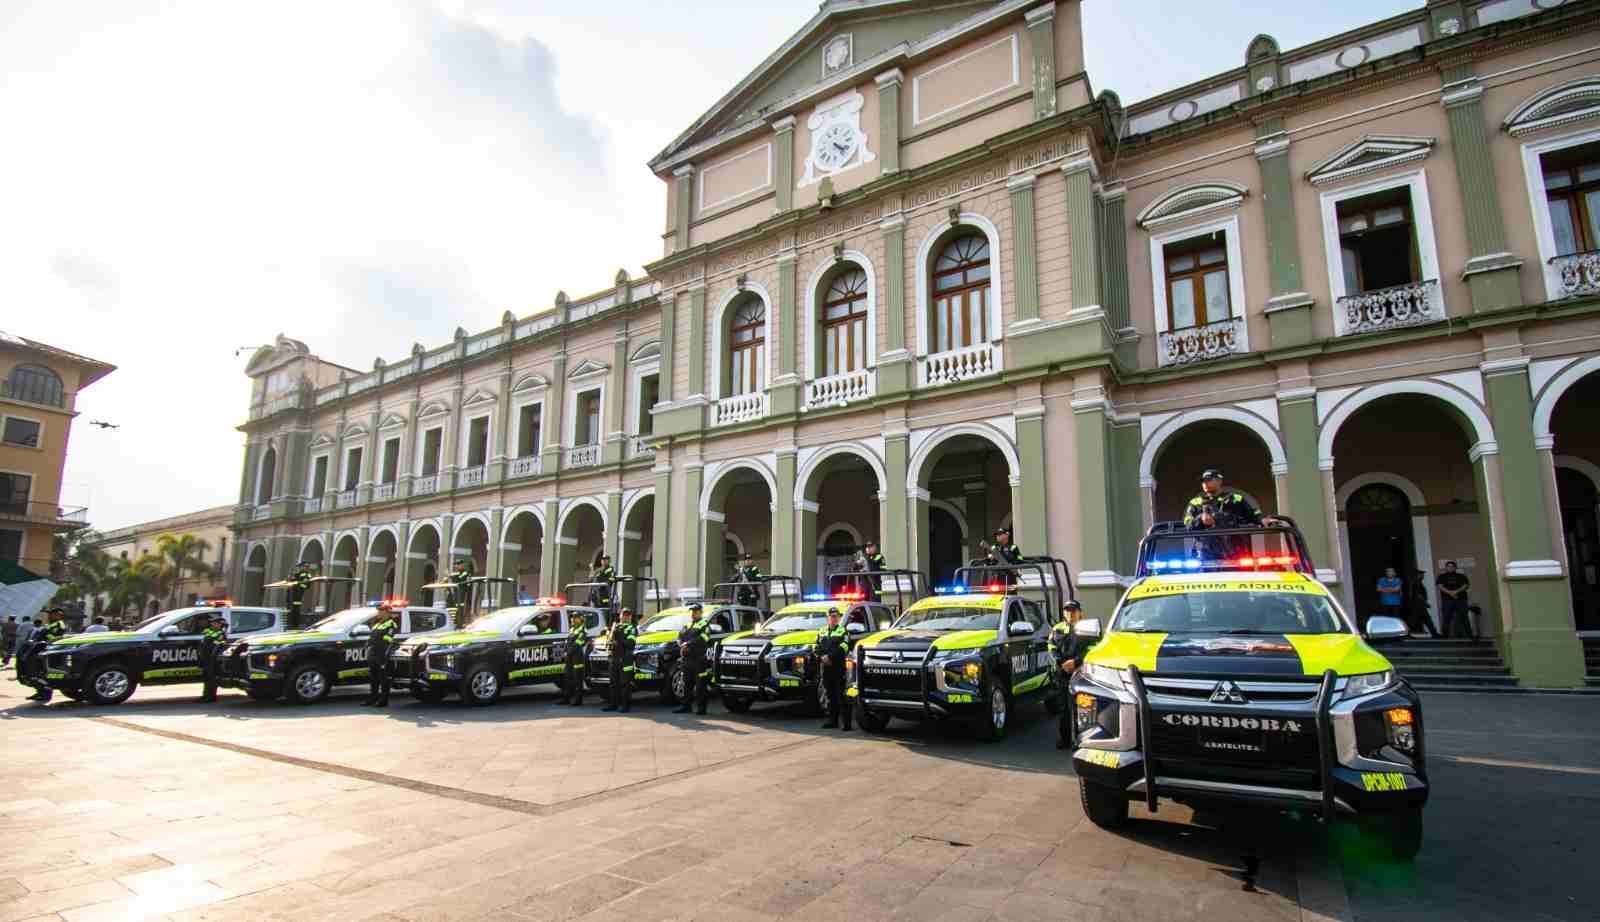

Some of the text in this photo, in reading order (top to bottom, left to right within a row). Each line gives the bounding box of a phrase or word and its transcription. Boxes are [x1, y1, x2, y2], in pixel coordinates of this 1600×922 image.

[152, 646, 199, 663] POLICÍA
[514, 645, 549, 663] POLICÍA
[1161, 713, 1301, 733] CORDOBA
